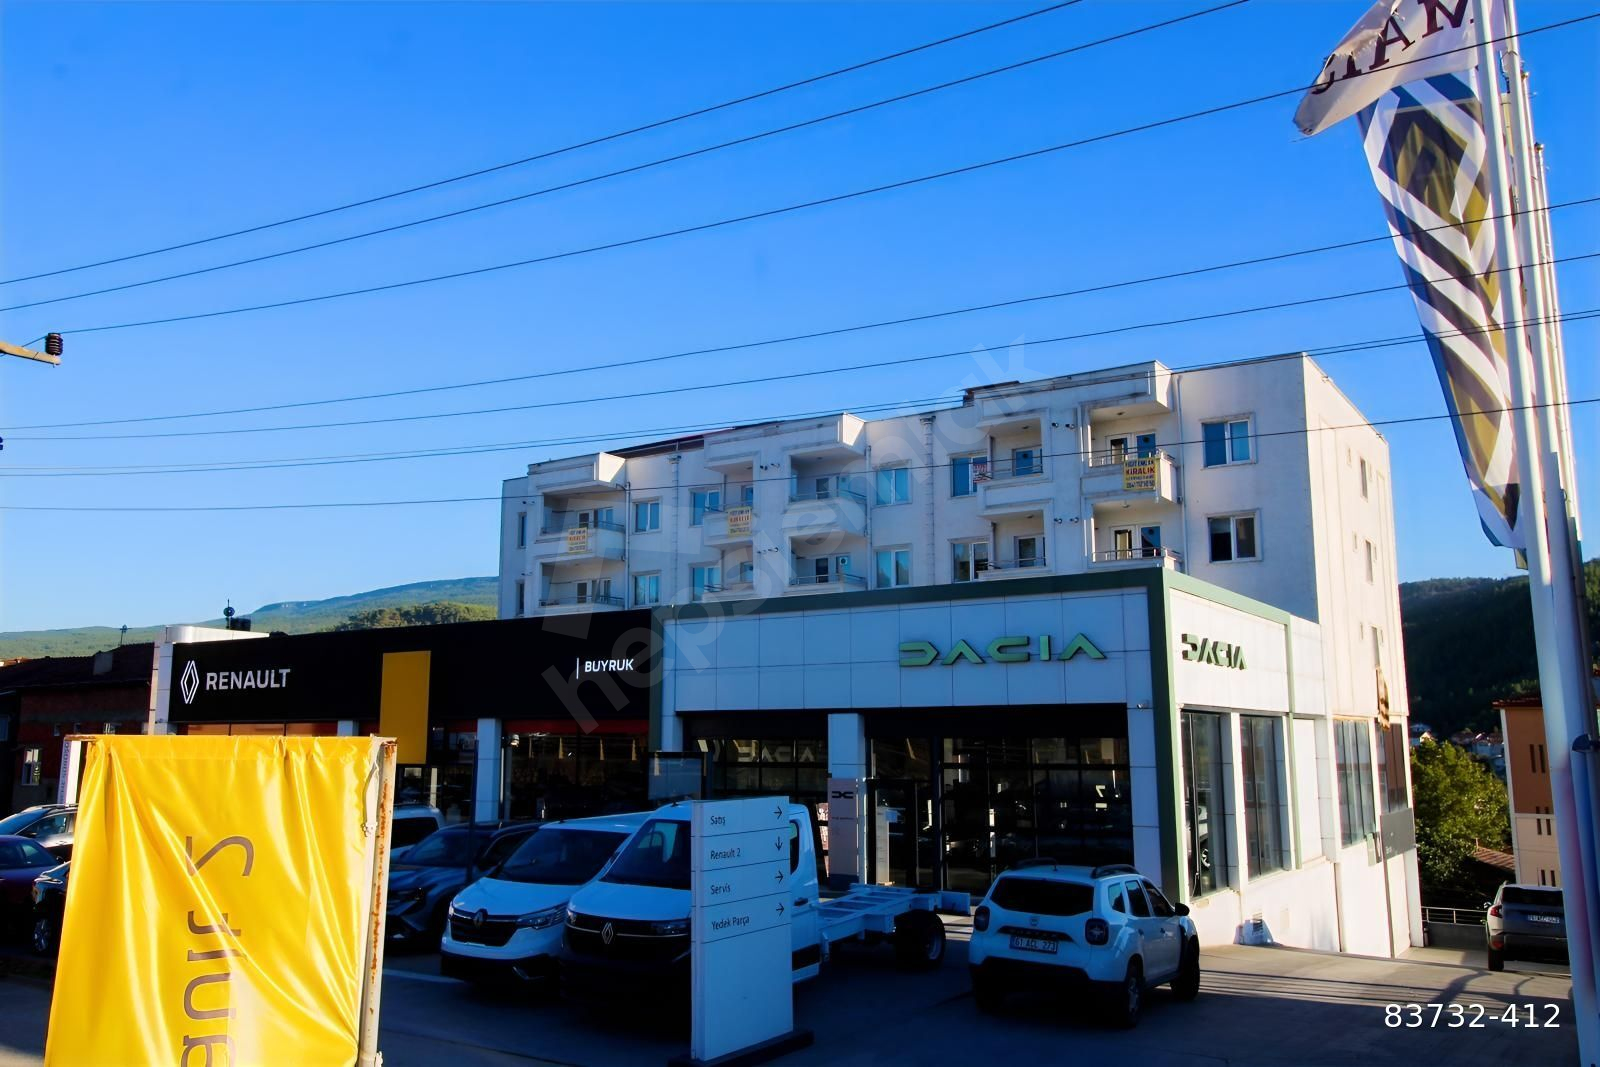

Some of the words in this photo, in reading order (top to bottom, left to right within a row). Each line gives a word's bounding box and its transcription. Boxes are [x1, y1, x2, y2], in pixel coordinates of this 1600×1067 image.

[899, 632, 1106, 668] DACIA
[1181, 633, 1247, 670] DACIA
[584, 658, 634, 673] BUYRUK
[205, 668, 291, 691] RENAULT
[710, 849, 737, 860] Renault
[736, 847, 741, 857] 2
[710, 882, 731, 895] Servis
[711, 917, 732, 930] Yedek
[732, 915, 750, 927] Parça
